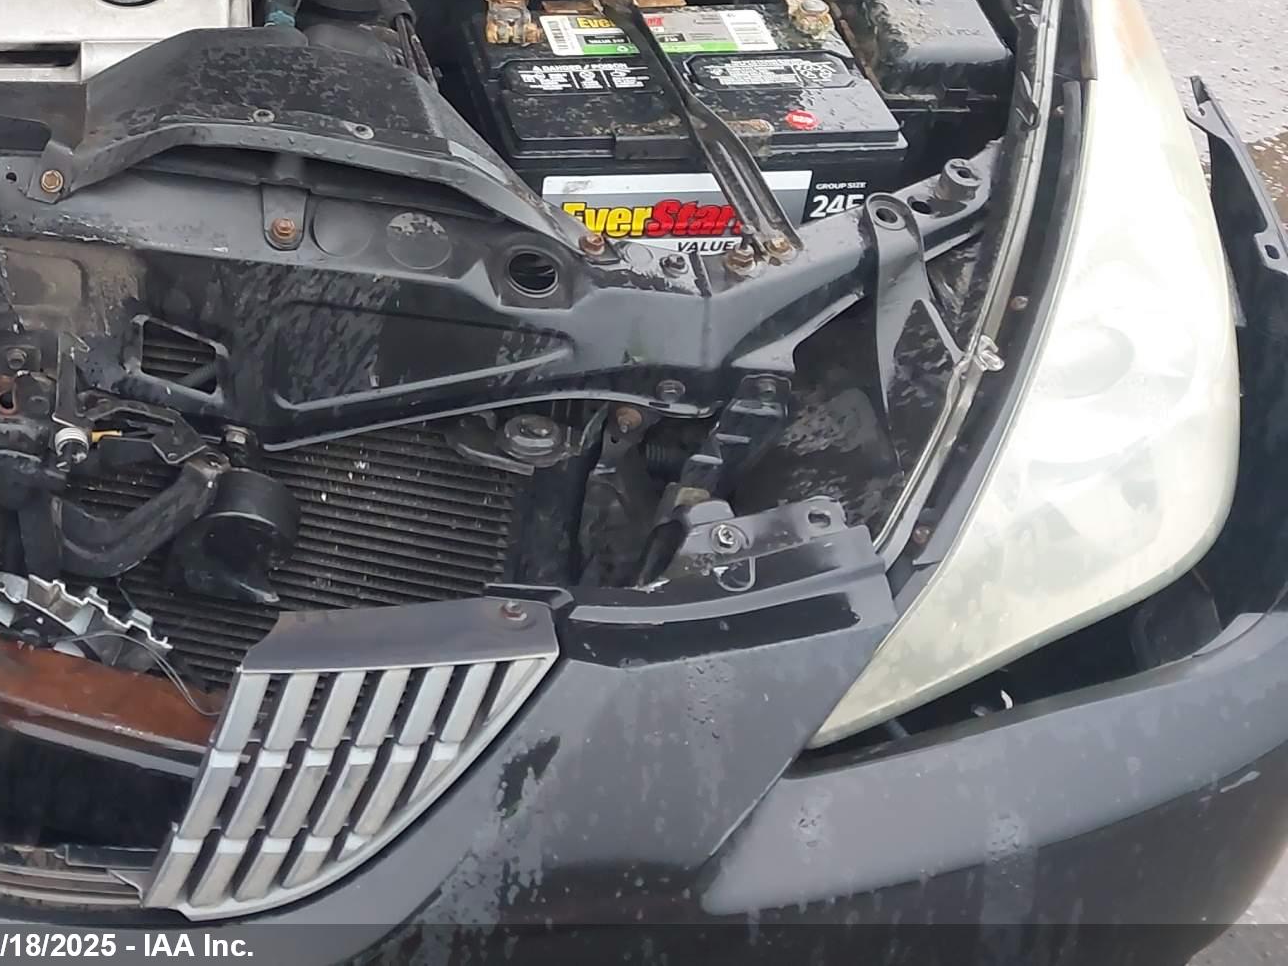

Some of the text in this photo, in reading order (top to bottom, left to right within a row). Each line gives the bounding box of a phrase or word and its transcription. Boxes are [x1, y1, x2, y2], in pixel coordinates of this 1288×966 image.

[815, 181, 867, 190] GROUP SIZE
[677, 240, 737, 253] VALUE
